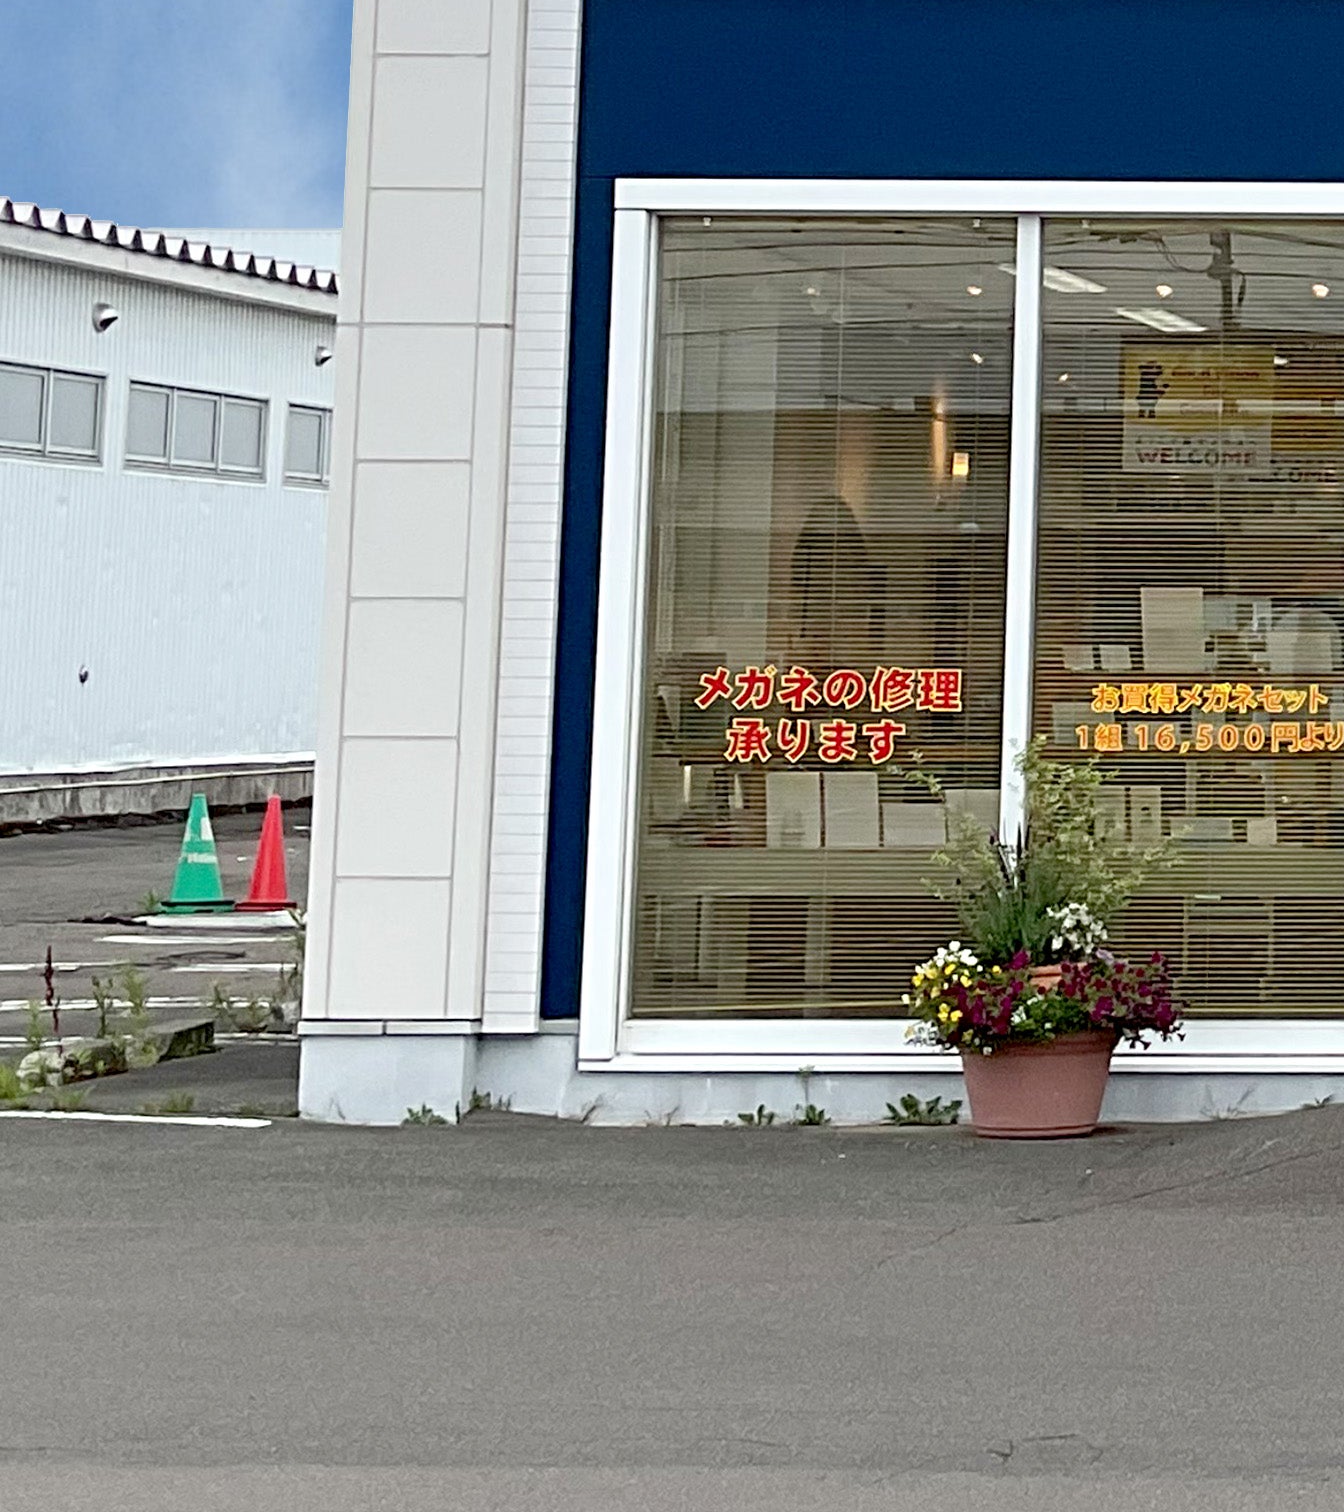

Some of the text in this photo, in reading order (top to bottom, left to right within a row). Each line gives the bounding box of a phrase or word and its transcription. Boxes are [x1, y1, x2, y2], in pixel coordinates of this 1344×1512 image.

[694, 664, 963, 713] メガネの修理
[1091, 682, 1329, 714] お買得メガネセット
[724, 718, 906, 765] 承ります
